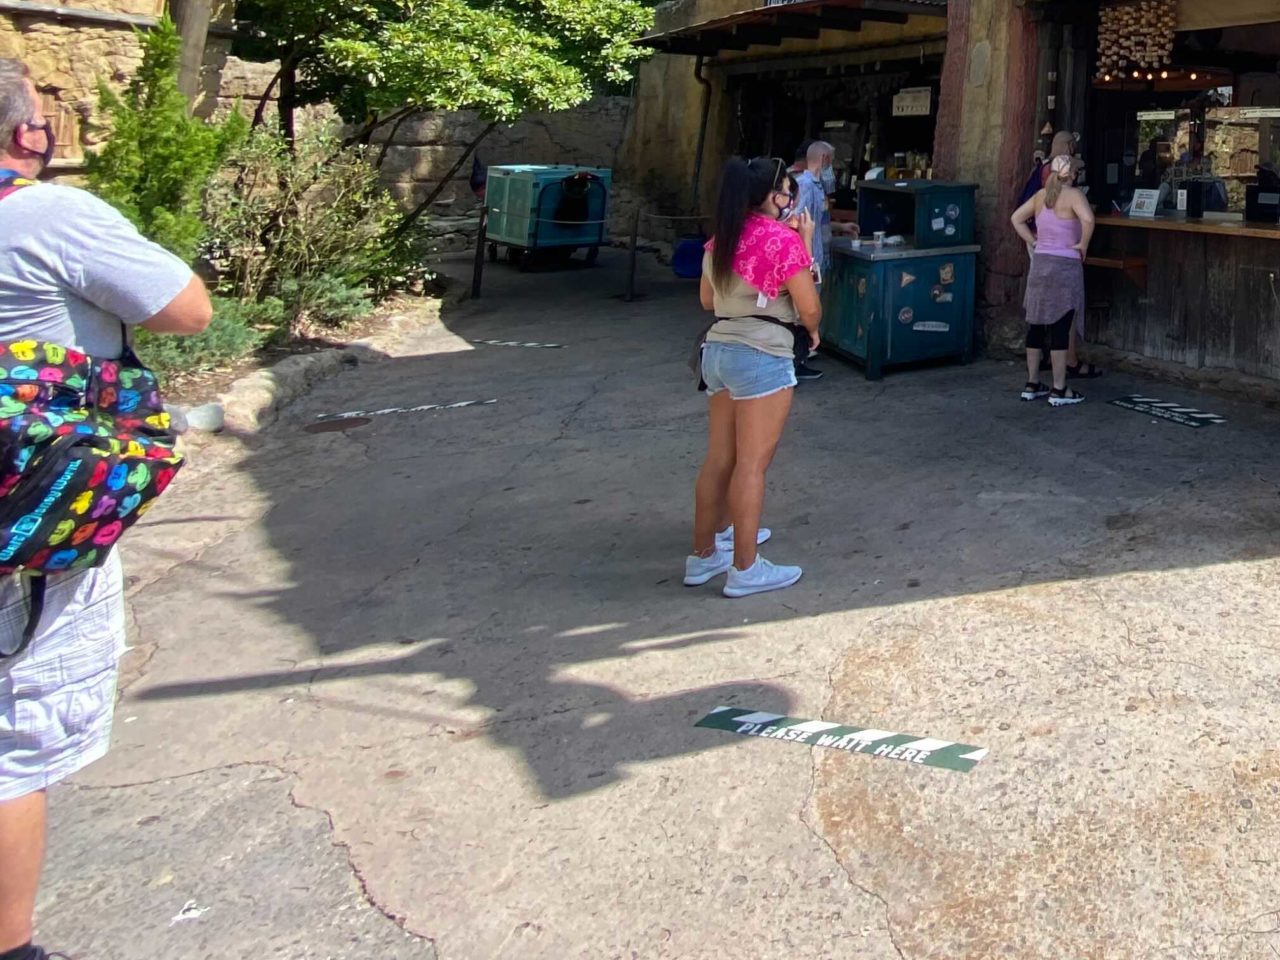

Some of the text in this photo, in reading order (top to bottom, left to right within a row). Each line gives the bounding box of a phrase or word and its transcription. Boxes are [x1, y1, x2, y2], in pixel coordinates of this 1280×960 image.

[736, 722, 932, 764] PLEASE WAIT HERE
